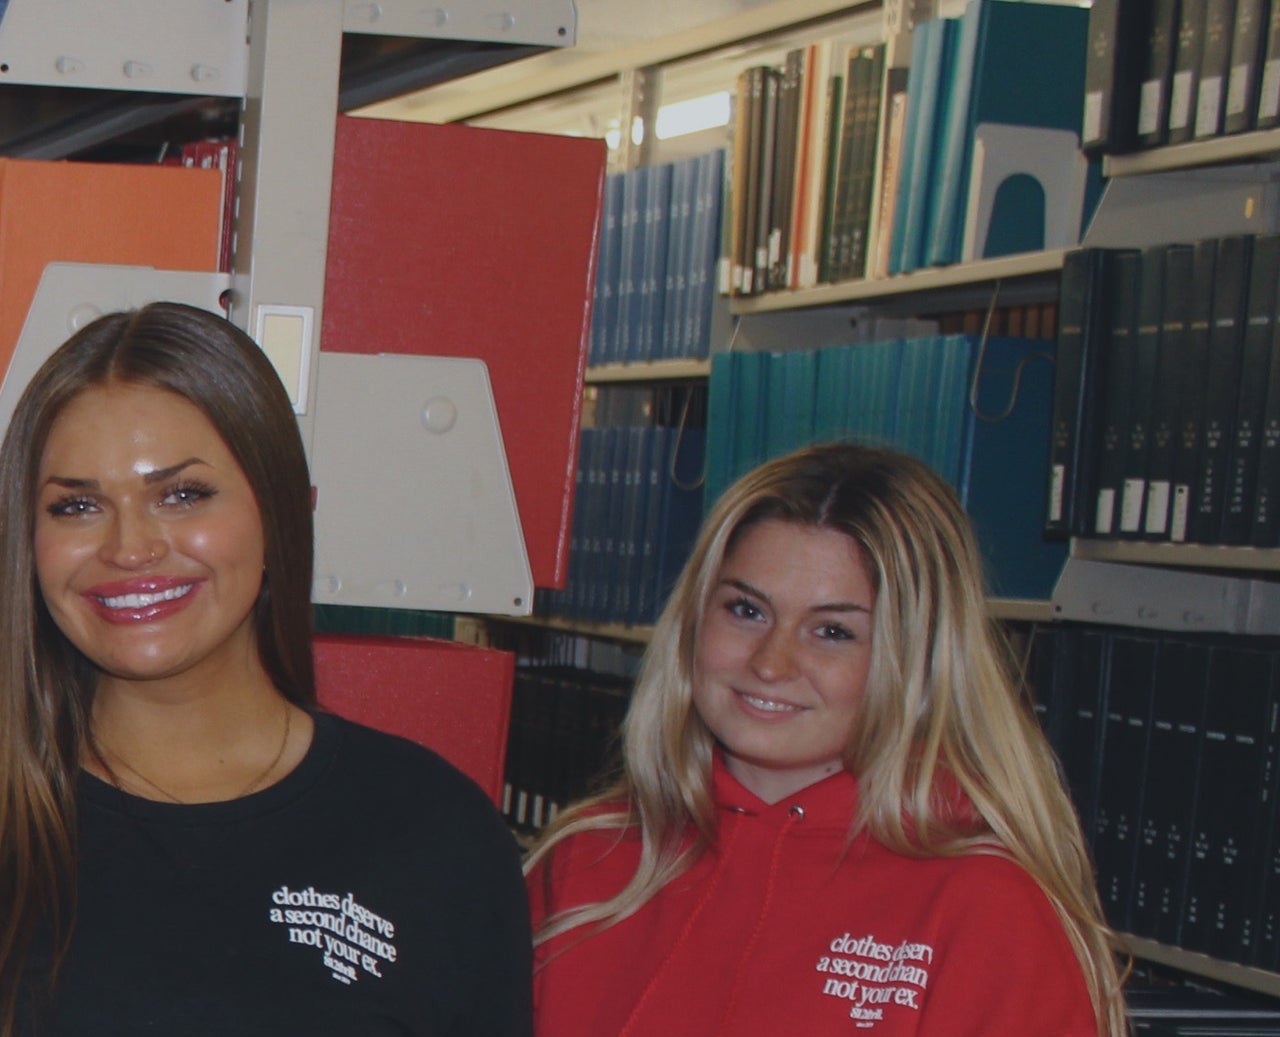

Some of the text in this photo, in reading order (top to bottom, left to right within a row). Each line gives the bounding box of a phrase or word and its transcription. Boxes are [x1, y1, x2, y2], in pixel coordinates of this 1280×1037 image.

[272, 885, 395, 939] clothes deserve
[269, 907, 397, 963] a second chance
[289, 927, 324, 948] not
[323, 934, 361, 965] your
[361, 954, 382, 978] ex.
[830, 932, 893, 961] clothes
[816, 956, 830, 972] a
[829, 956, 893, 983] second
[823, 978, 919, 1010] not your ex.
